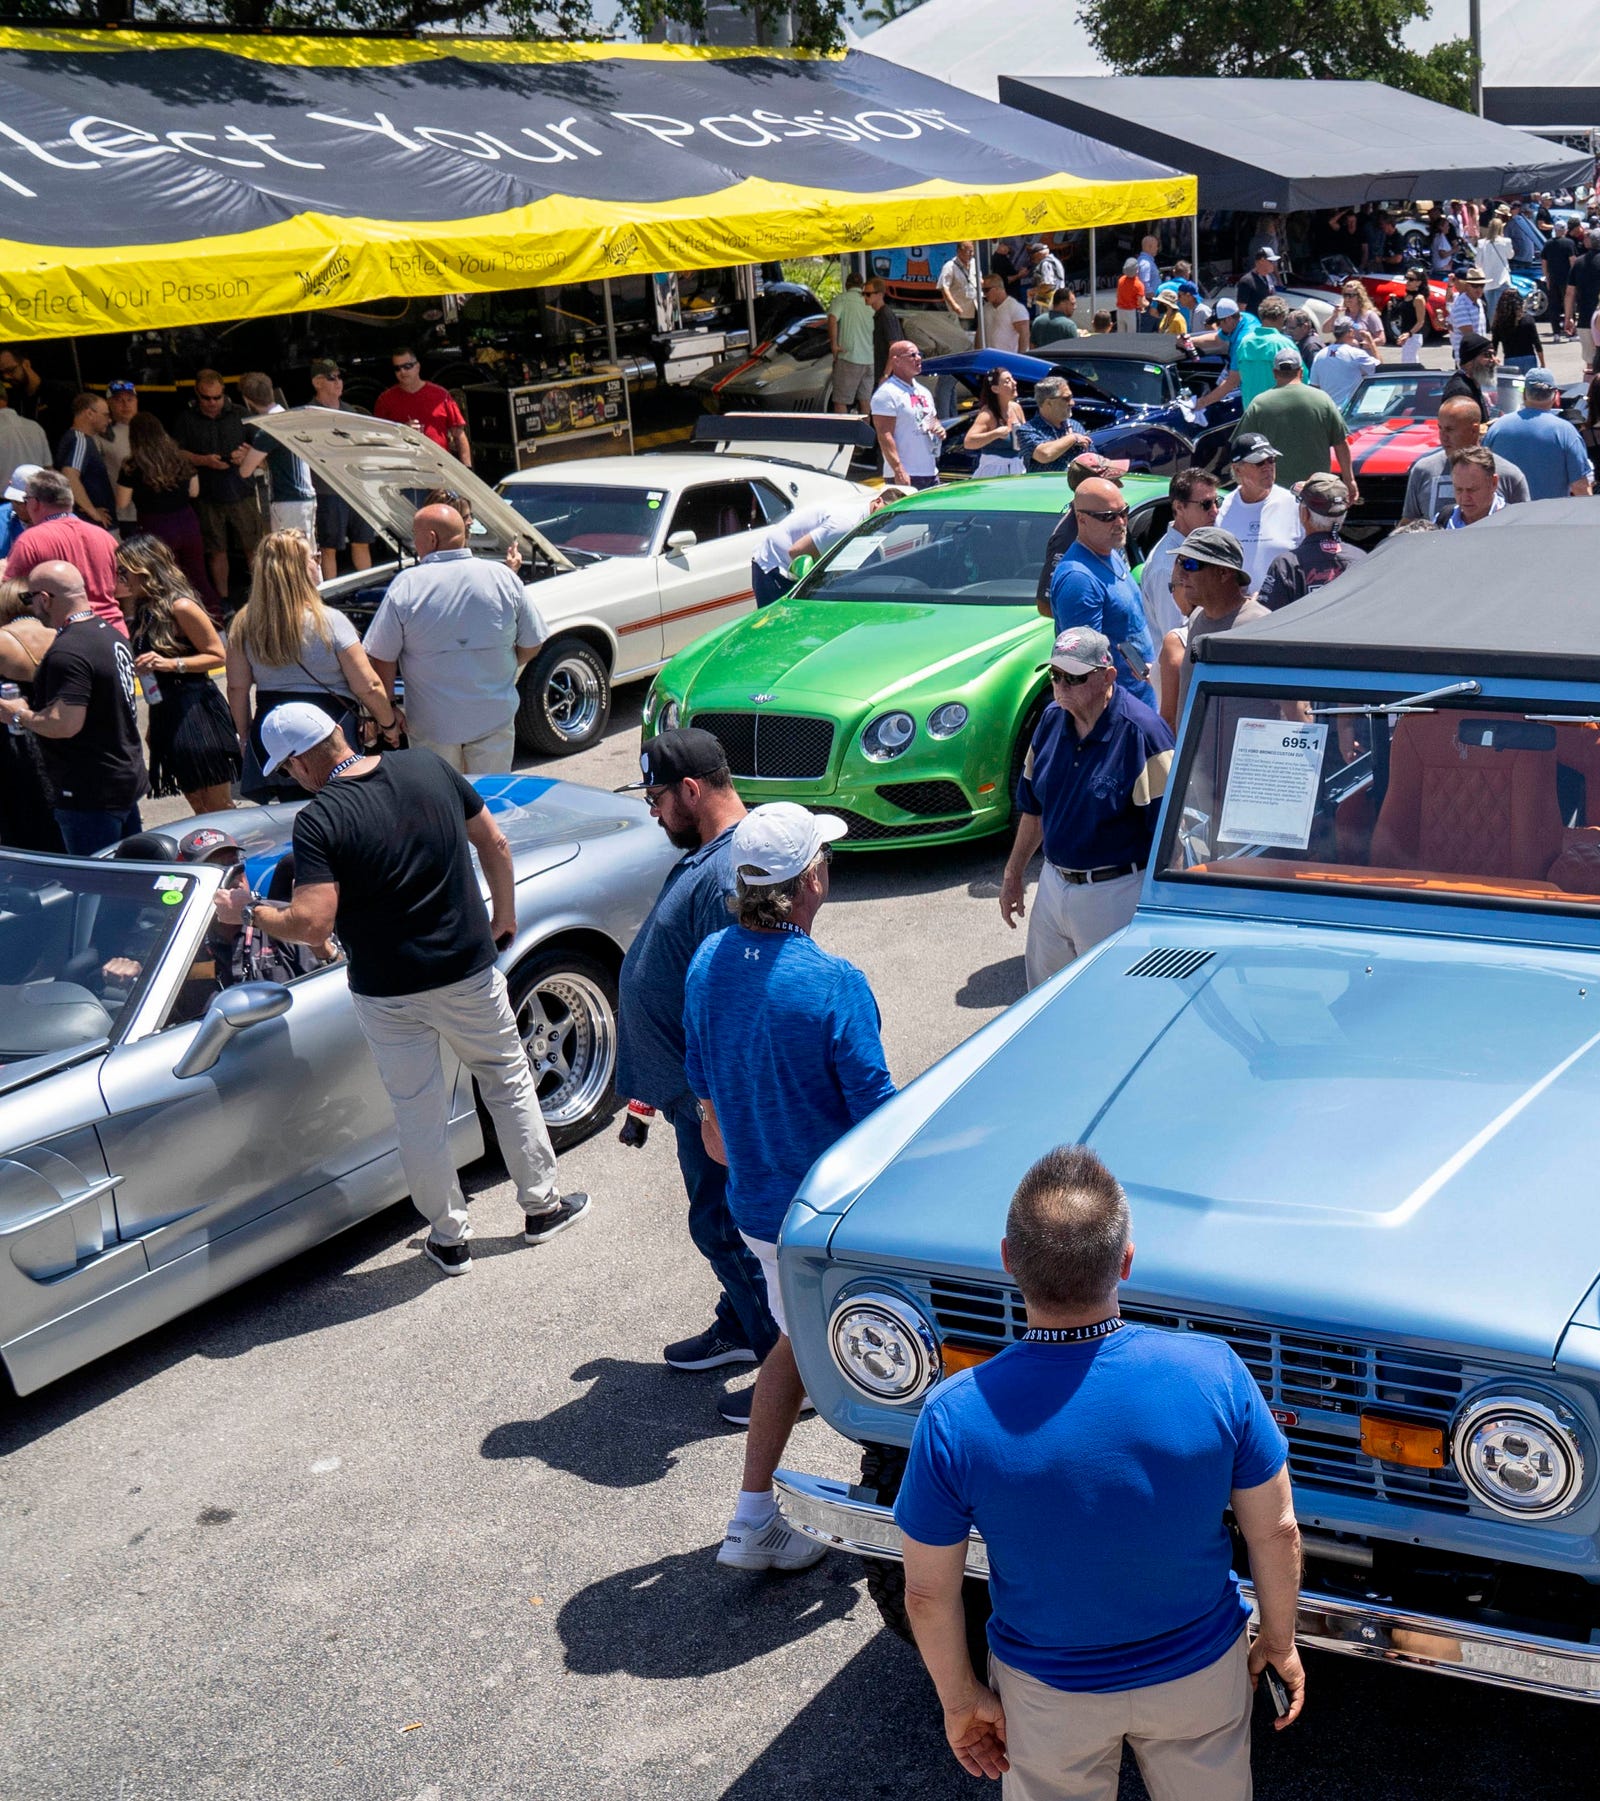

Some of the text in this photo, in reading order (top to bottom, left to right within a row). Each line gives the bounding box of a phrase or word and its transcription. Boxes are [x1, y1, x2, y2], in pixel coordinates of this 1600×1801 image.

[305, 111, 603, 163] Your
[896, 210, 1003, 231] Reflect Your Passion
[667, 229, 807, 254] Reflect Your Passion
[389, 250, 566, 279] Reflect Your Passion
[0, 278, 250, 318] Reflect Your Passion
[1282, 736, 1319, 750] 695.1
